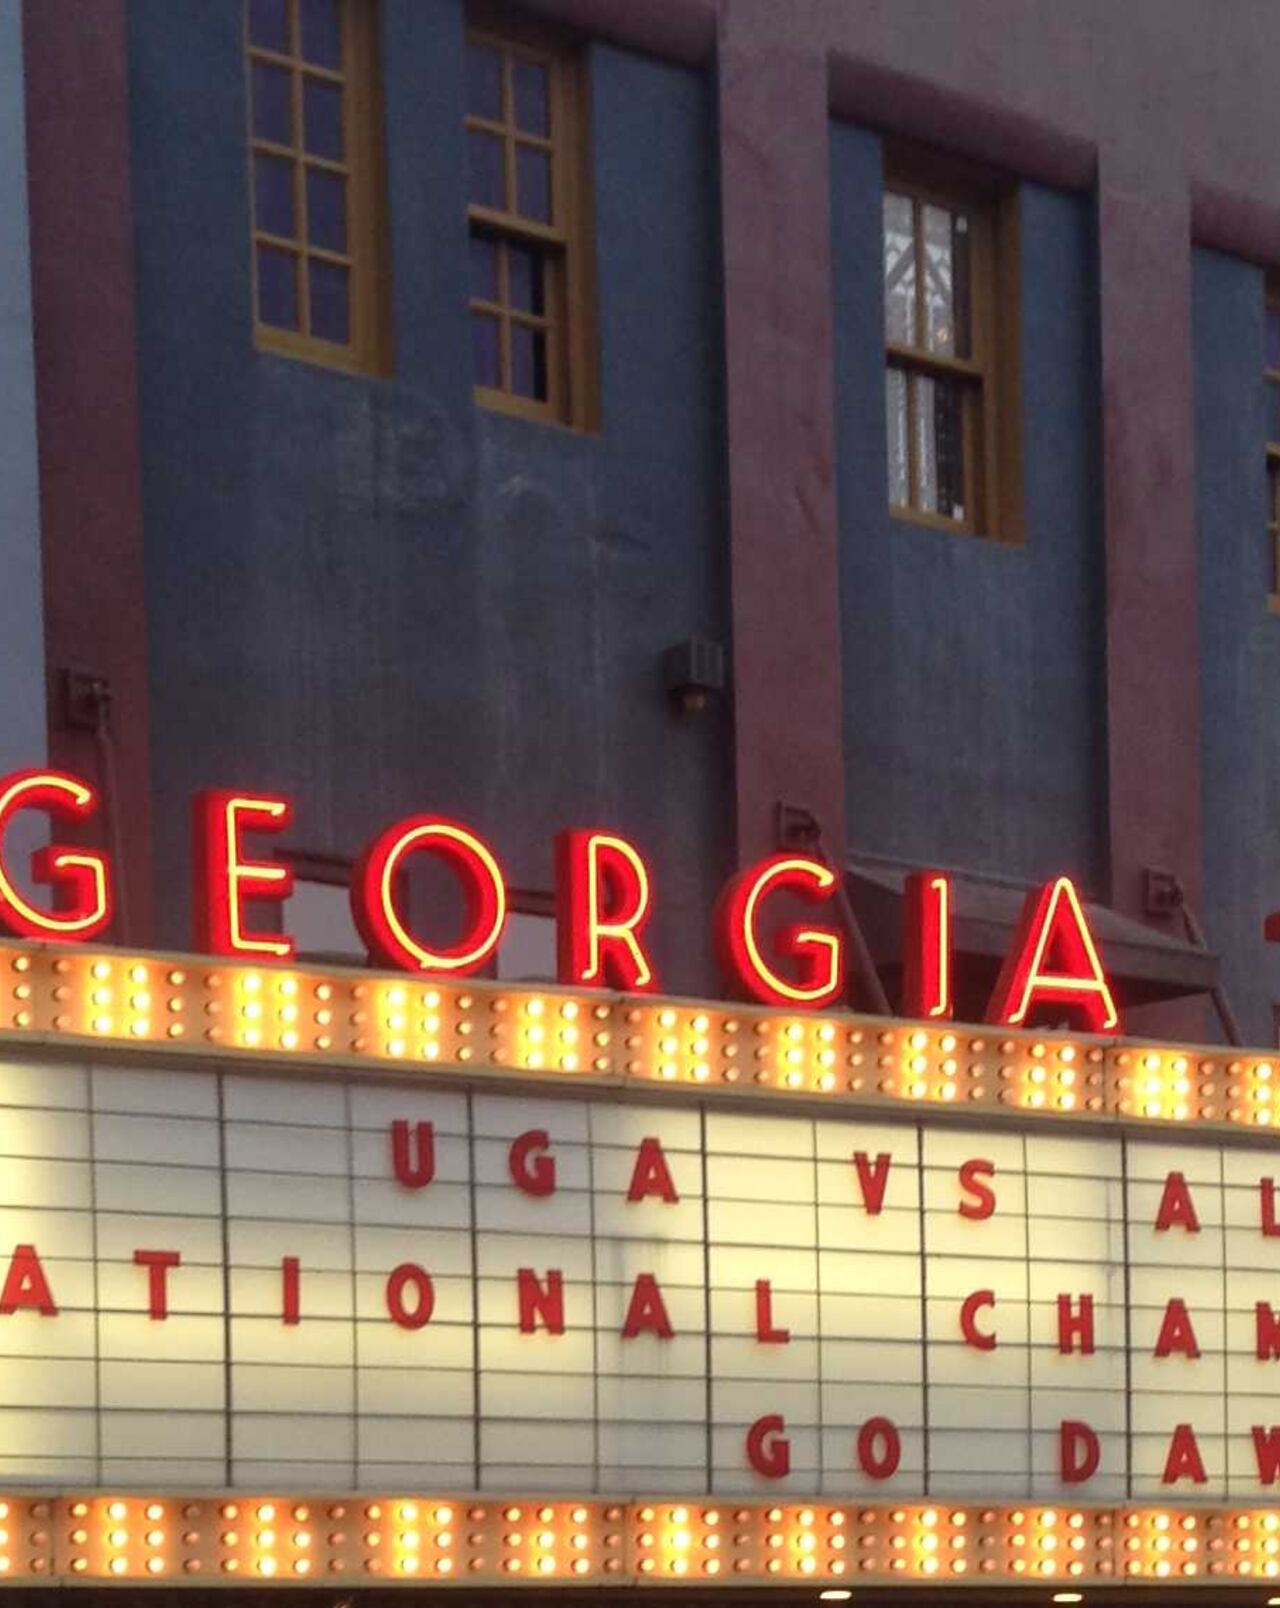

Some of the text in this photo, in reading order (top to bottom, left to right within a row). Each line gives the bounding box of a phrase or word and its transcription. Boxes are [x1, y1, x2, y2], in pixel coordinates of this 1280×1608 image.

[391, 1121, 678, 1205] UGA
[852, 1151, 997, 1222] VS
[745, 1414, 902, 1482] GO
